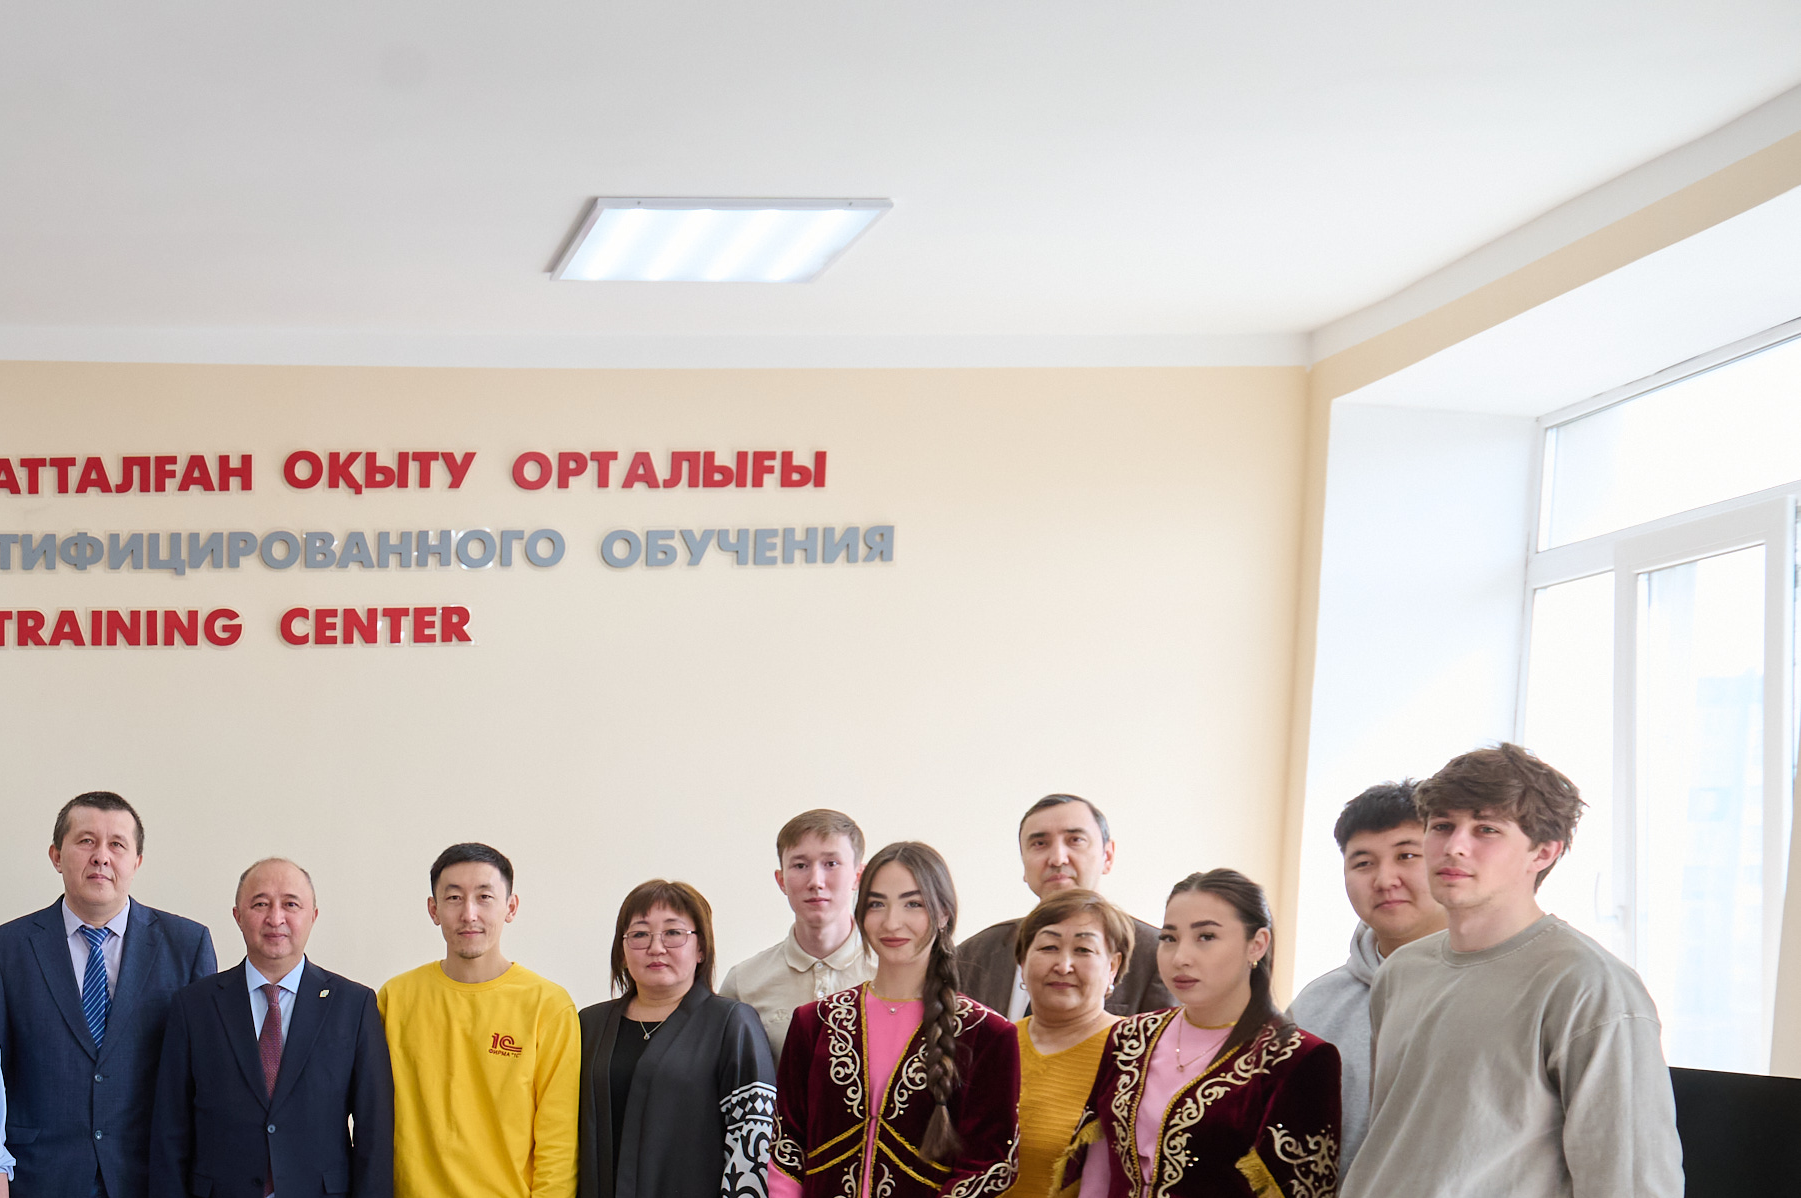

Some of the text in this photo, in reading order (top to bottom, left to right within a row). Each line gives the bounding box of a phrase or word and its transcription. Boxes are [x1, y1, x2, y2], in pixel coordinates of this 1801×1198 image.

[284, 451, 477, 494] ОҚЫТУ
[512, 451, 827, 490] ОРТАЛЫҒЫ
[600, 525, 894, 569] ОБУЧЕНИЯ
[280, 606, 472, 646] CENTER
